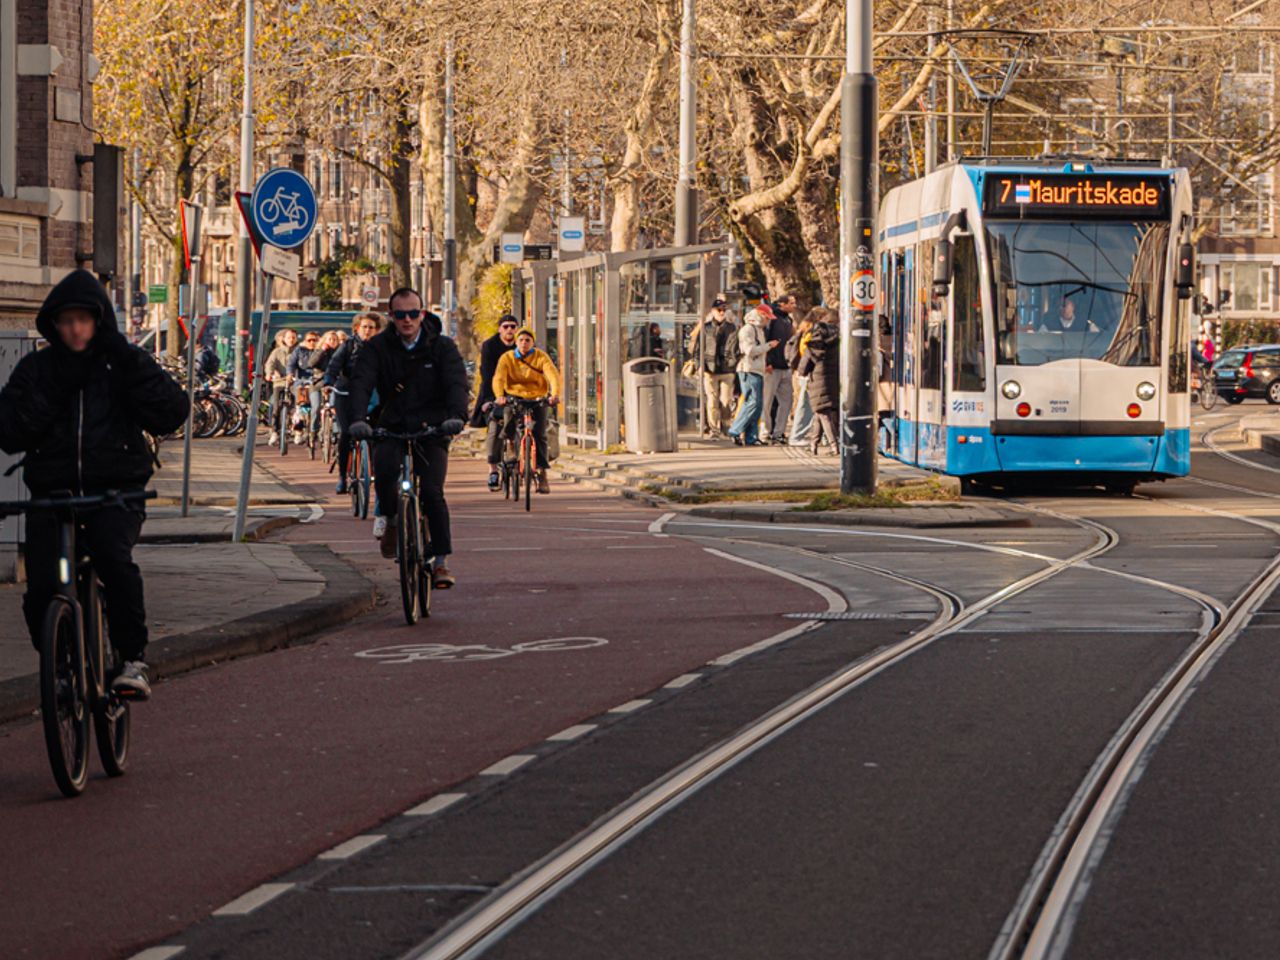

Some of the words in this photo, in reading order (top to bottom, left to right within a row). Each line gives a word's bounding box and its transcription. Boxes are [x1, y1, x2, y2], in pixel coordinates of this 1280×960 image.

[1000, 180, 1012, 204] 7
[1029, 179, 1159, 205] Mauritskade
[855, 280, 877, 300] 30
